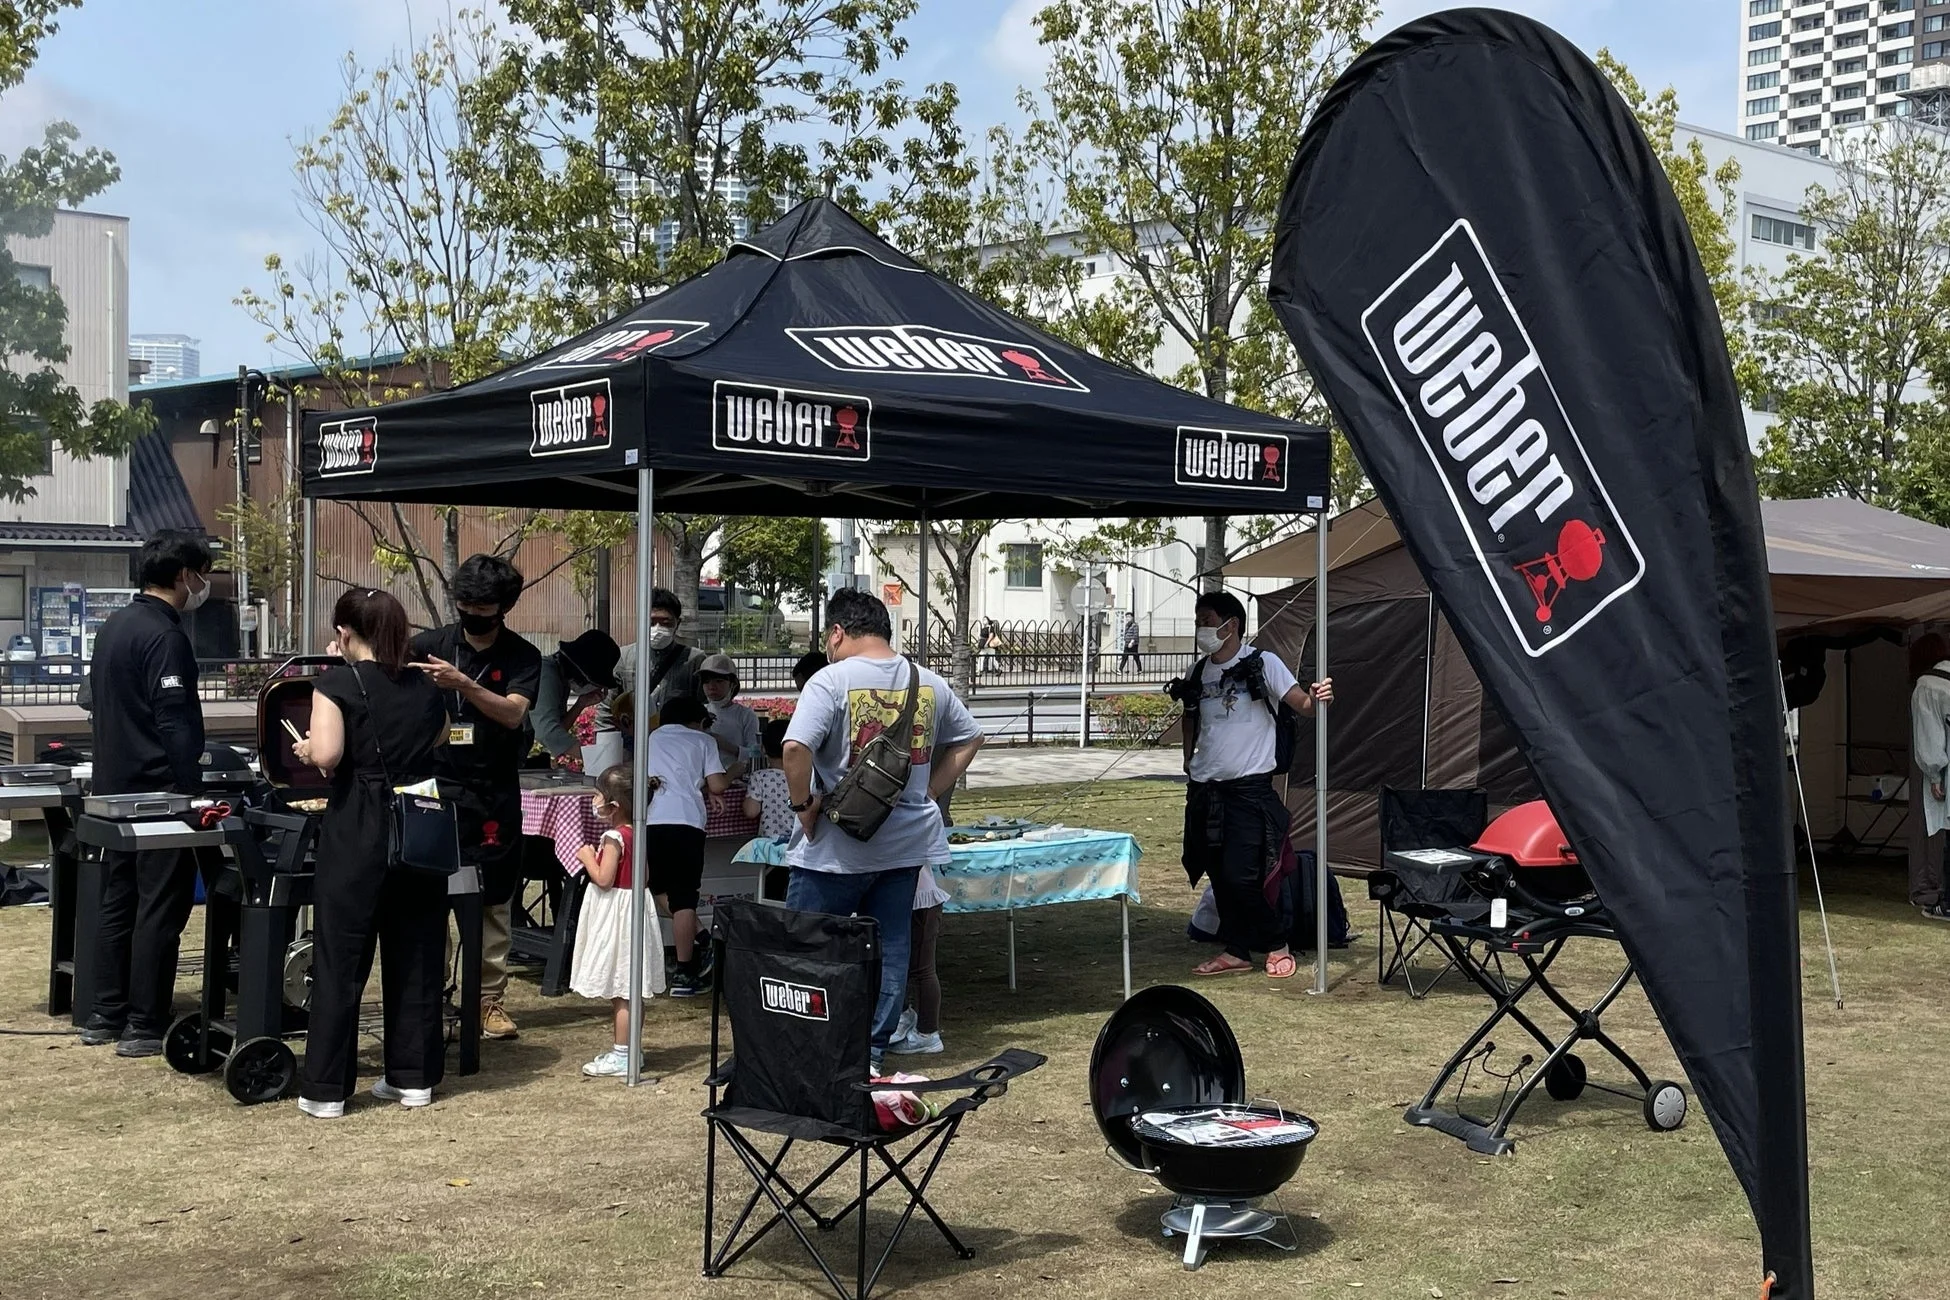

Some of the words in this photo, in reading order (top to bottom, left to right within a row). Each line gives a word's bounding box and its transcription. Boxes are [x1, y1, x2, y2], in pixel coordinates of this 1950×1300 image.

[813, 327, 1008, 376] weber
[539, 387, 591, 446] weber
[725, 389, 832, 448] weber
[1393, 261, 1574, 533] weber
[323, 422, 363, 469] weber
[1185, 431, 1260, 480] weber
[765, 983, 810, 1013] weber
